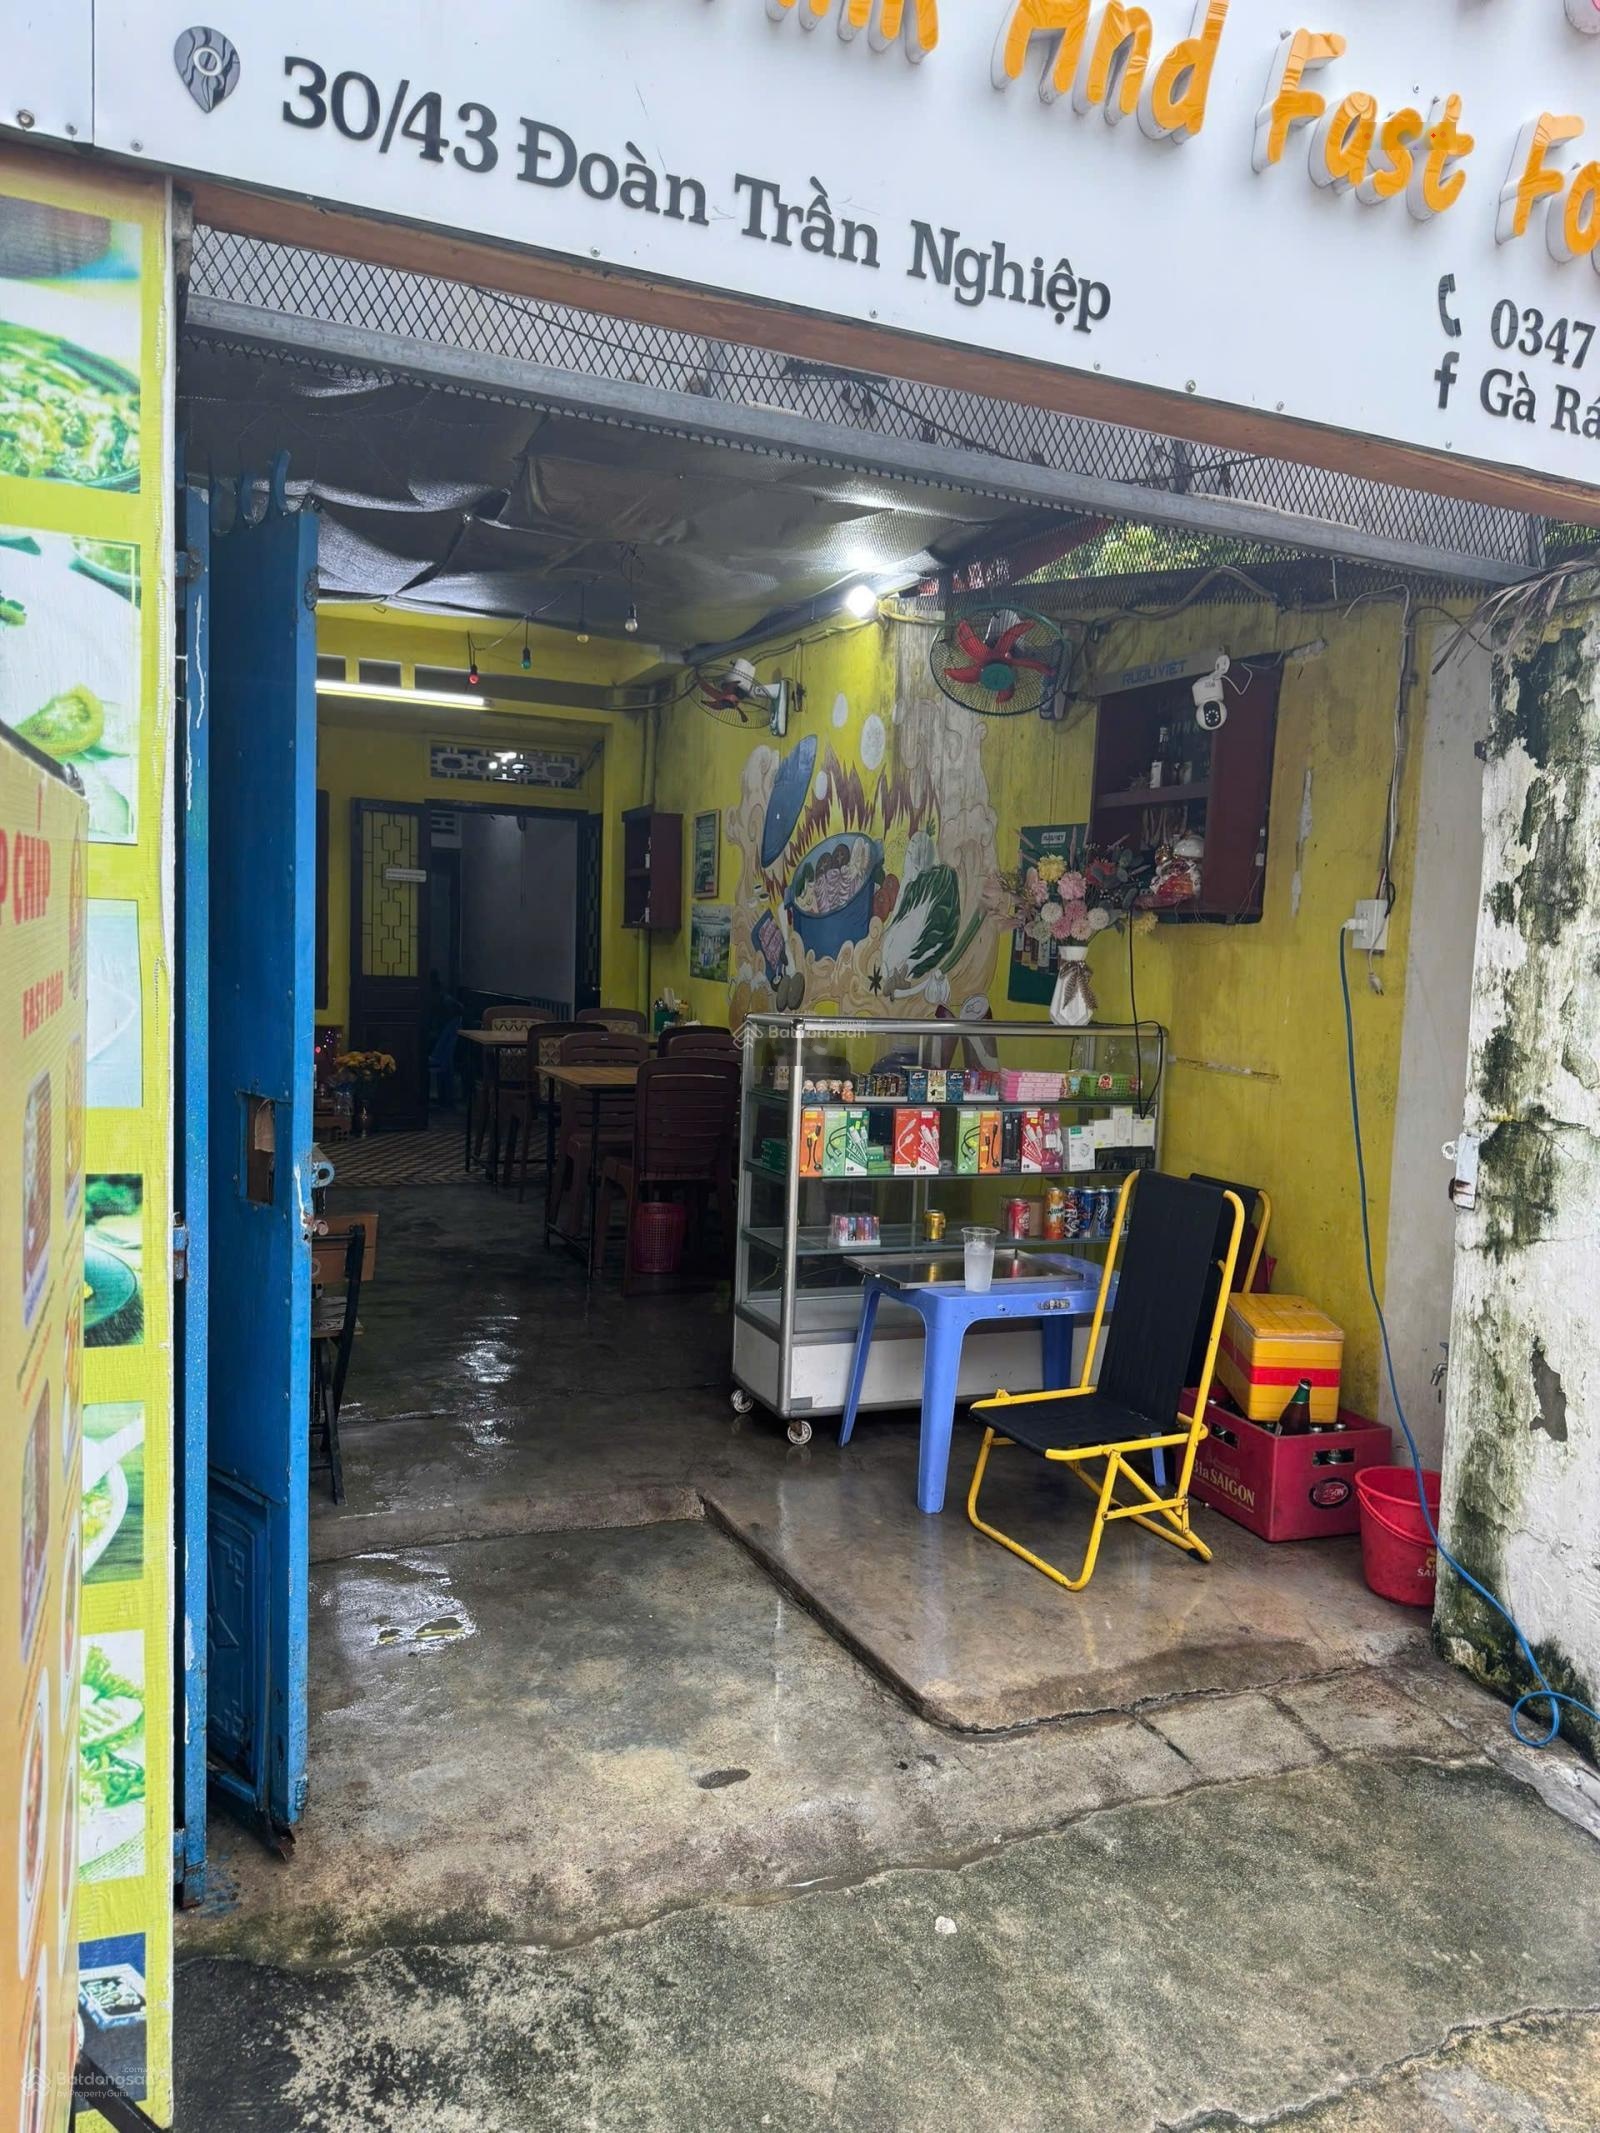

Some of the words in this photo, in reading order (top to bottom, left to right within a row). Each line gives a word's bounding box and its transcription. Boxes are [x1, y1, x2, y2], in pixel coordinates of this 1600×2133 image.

[1254, 28, 1475, 219] Fast
[282, 55, 499, 174] 30/43
[516, 116, 710, 226] Đoàn
[733, 172, 881, 269] Trần
[906, 218, 1112, 334] Nghiệp
[1490, 298, 1597, 370] 0347
[1479, 367, 1537, 424] Gà
[1550, 383, 1600, 441] Rá
[1210, 1467, 1255, 1507] SAIGON
